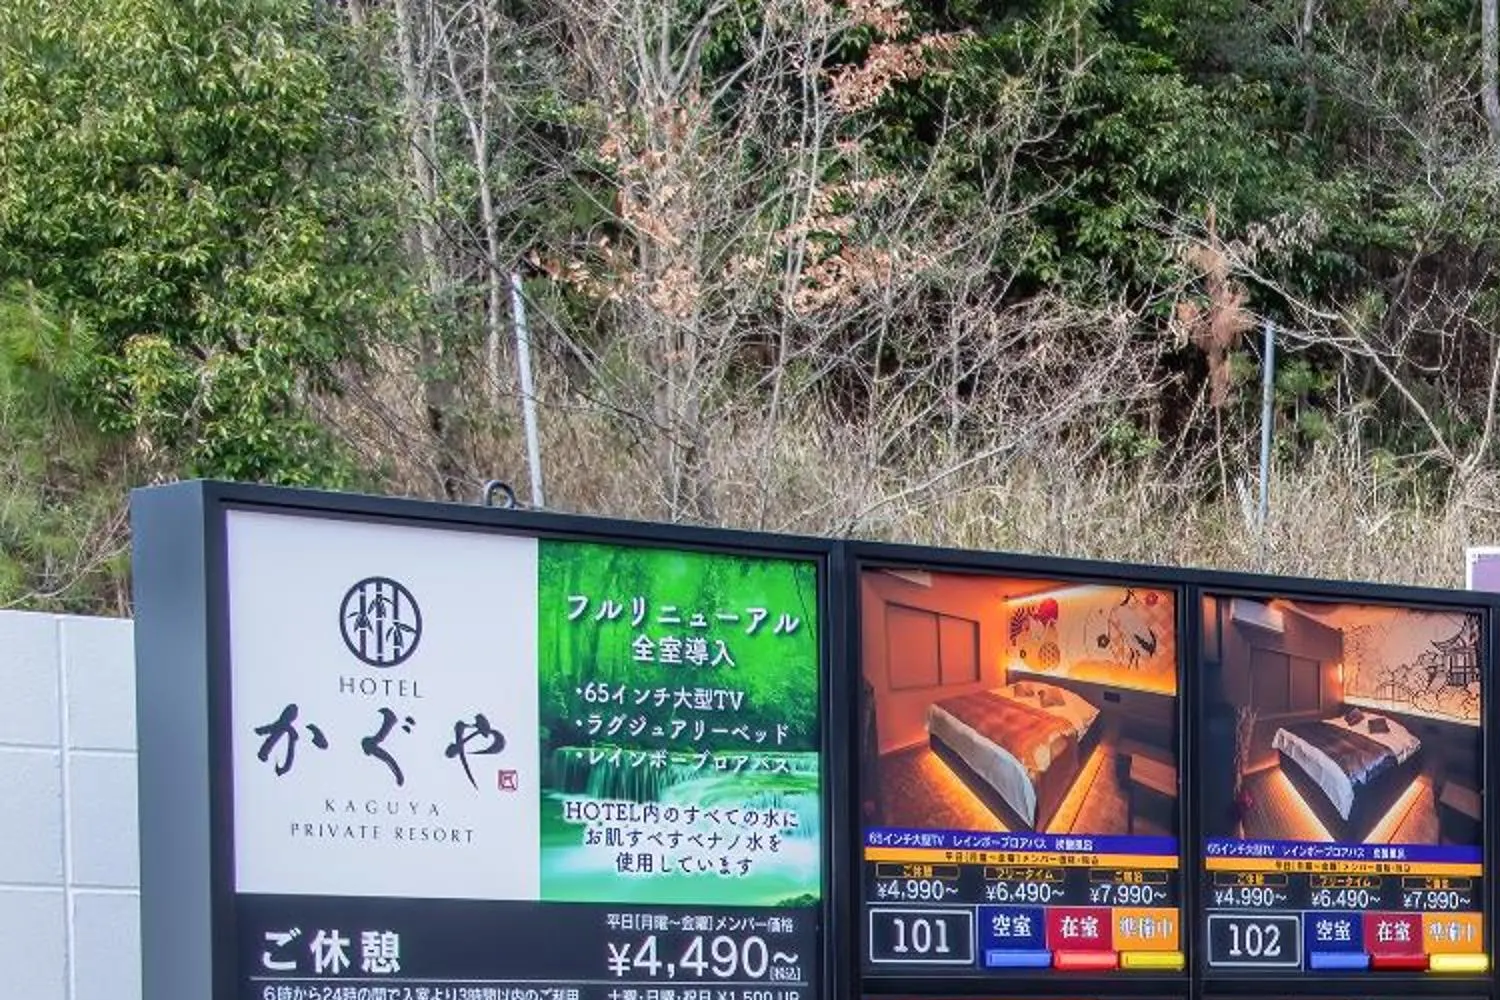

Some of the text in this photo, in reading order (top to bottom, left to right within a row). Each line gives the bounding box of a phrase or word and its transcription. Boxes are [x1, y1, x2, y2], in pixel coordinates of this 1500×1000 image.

[567, 595, 799, 634] フルリニューアル
[632, 634, 735, 667] 全室導入
[340, 676, 422, 698] HOTEL
[255, 703, 506, 796] かぐや
[325, 799, 440, 816] KAGUYA
[566, 802, 798, 828] HOTEL内のすべての水に
[291, 823, 474, 843] PRIVATE RESORT
[616, 854, 752, 876] 使用しています
[263, 928, 400, 973] ご休憩
[894, 918, 950, 953] 101
[992, 915, 1031, 937] 空室
[1060, 916, 1098, 938] 在室
[1229, 924, 1281, 956] 102
[1316, 921, 1351, 941] 空室
[1376, 921, 1410, 942] 在室
